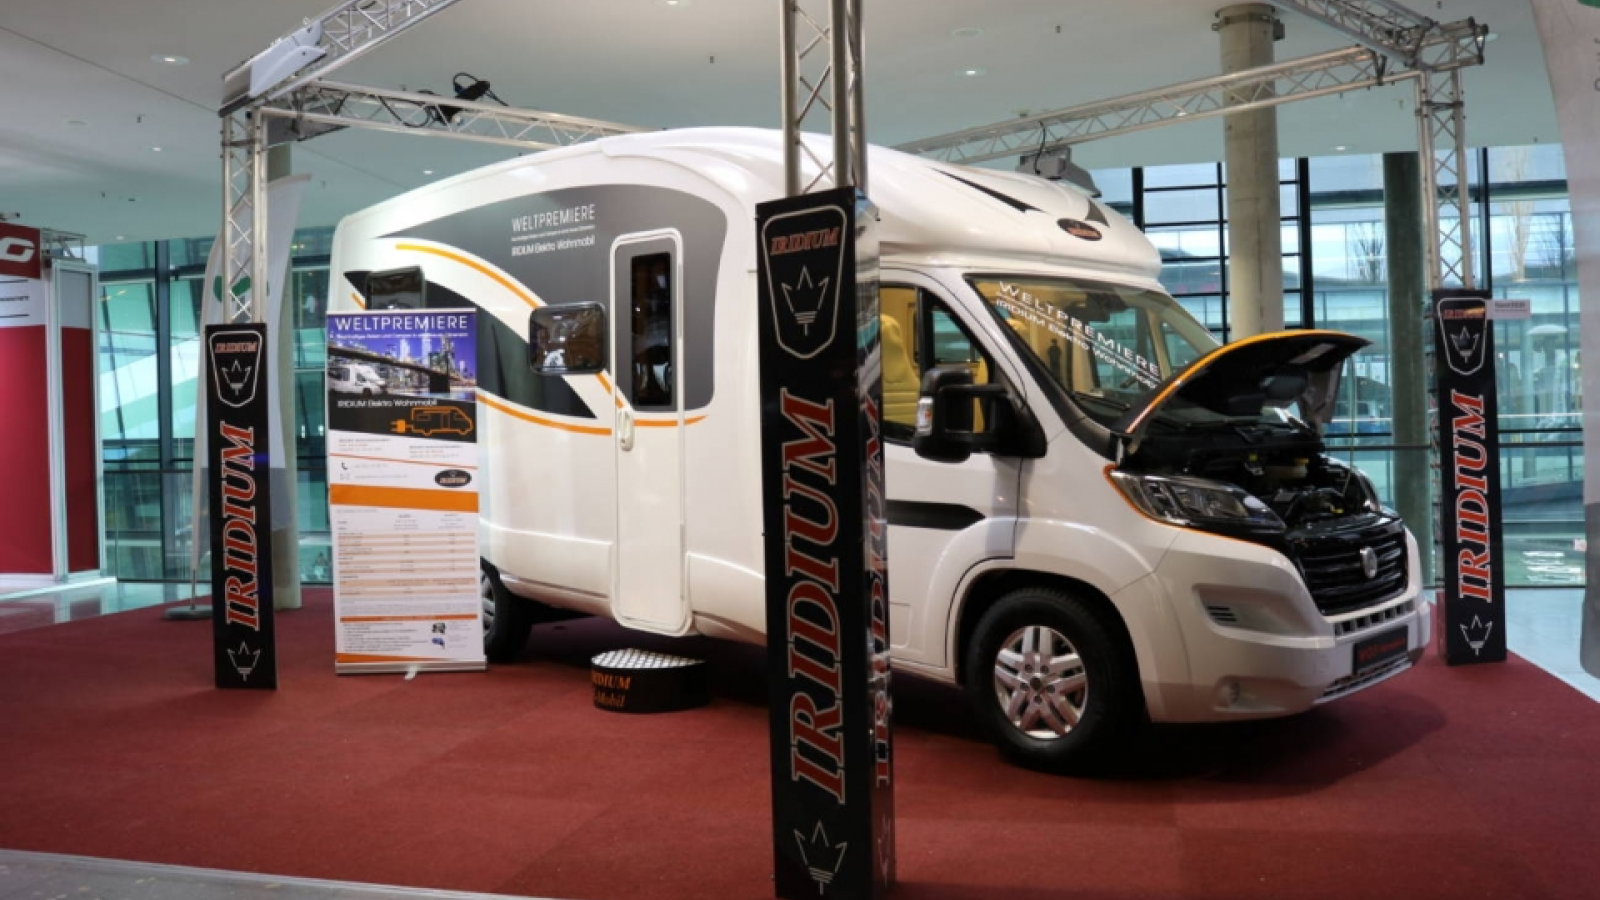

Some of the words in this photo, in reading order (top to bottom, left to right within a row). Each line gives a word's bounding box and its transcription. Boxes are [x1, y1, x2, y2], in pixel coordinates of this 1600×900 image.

[511, 203, 595, 231] WELTPREMIERE
[770, 226, 840, 256] IRIDIUM
[335, 315, 468, 331] WELTPREMIERE
[999, 280, 1159, 376] WELTPREMIERE
[220, 421, 260, 631] IRIDIUM
[1451, 389, 1492, 603] IRIDIUM
[780, 386, 845, 805] IRIDIUM
